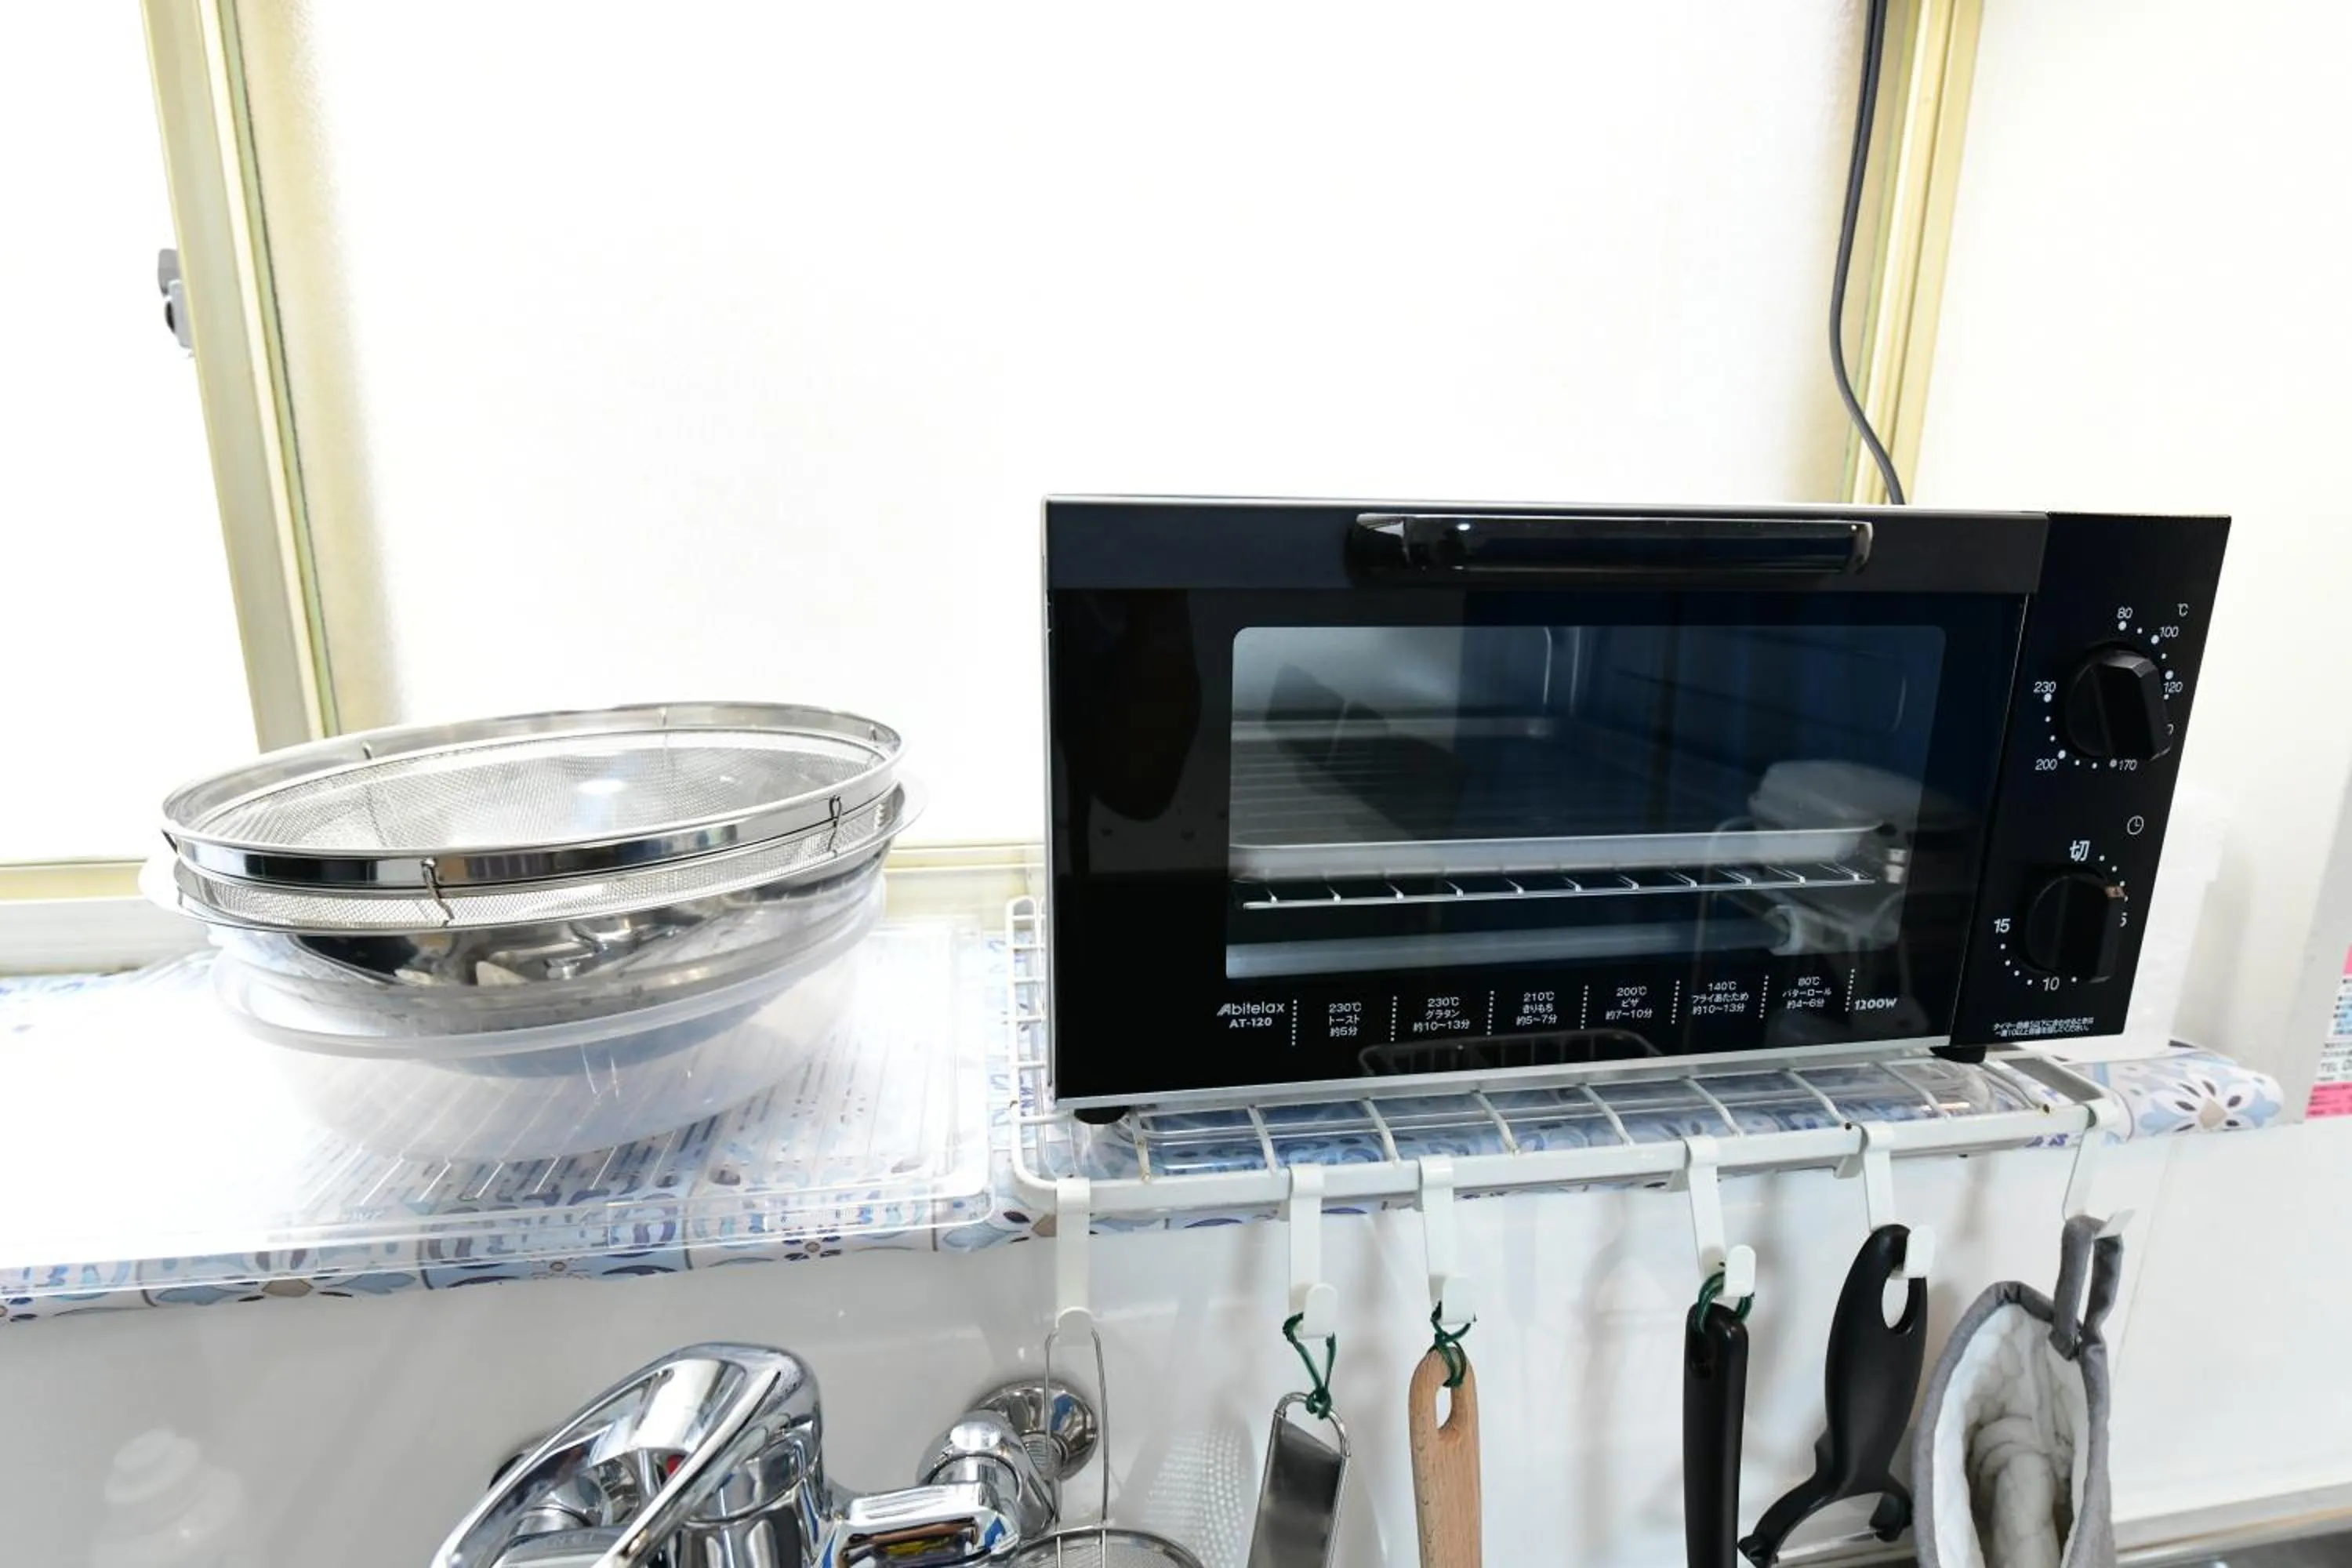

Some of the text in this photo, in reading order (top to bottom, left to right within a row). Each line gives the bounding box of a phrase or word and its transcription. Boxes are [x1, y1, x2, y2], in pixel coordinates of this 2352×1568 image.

[2117, 606, 2133, 619] 80
[2158, 626, 2180, 638] 100
[2033, 681, 2056, 693] 230
[2163, 681, 2183, 693] 120
[2034, 758, 2058, 771] 200
[2119, 759, 2138, 771] 170
[2069, 840, 2090, 862] 切
[1994, 918, 2011, 934] 15
[2042, 976, 2060, 991] 10
[1216, 1001, 1285, 1017] Abitelax
[1854, 997, 1897, 1011] 1200W
[1329, 1014, 1359, 1026] トースト
[1425, 1009, 1461, 1020] グラタン
[1229, 1017, 1272, 1029] AT-120
